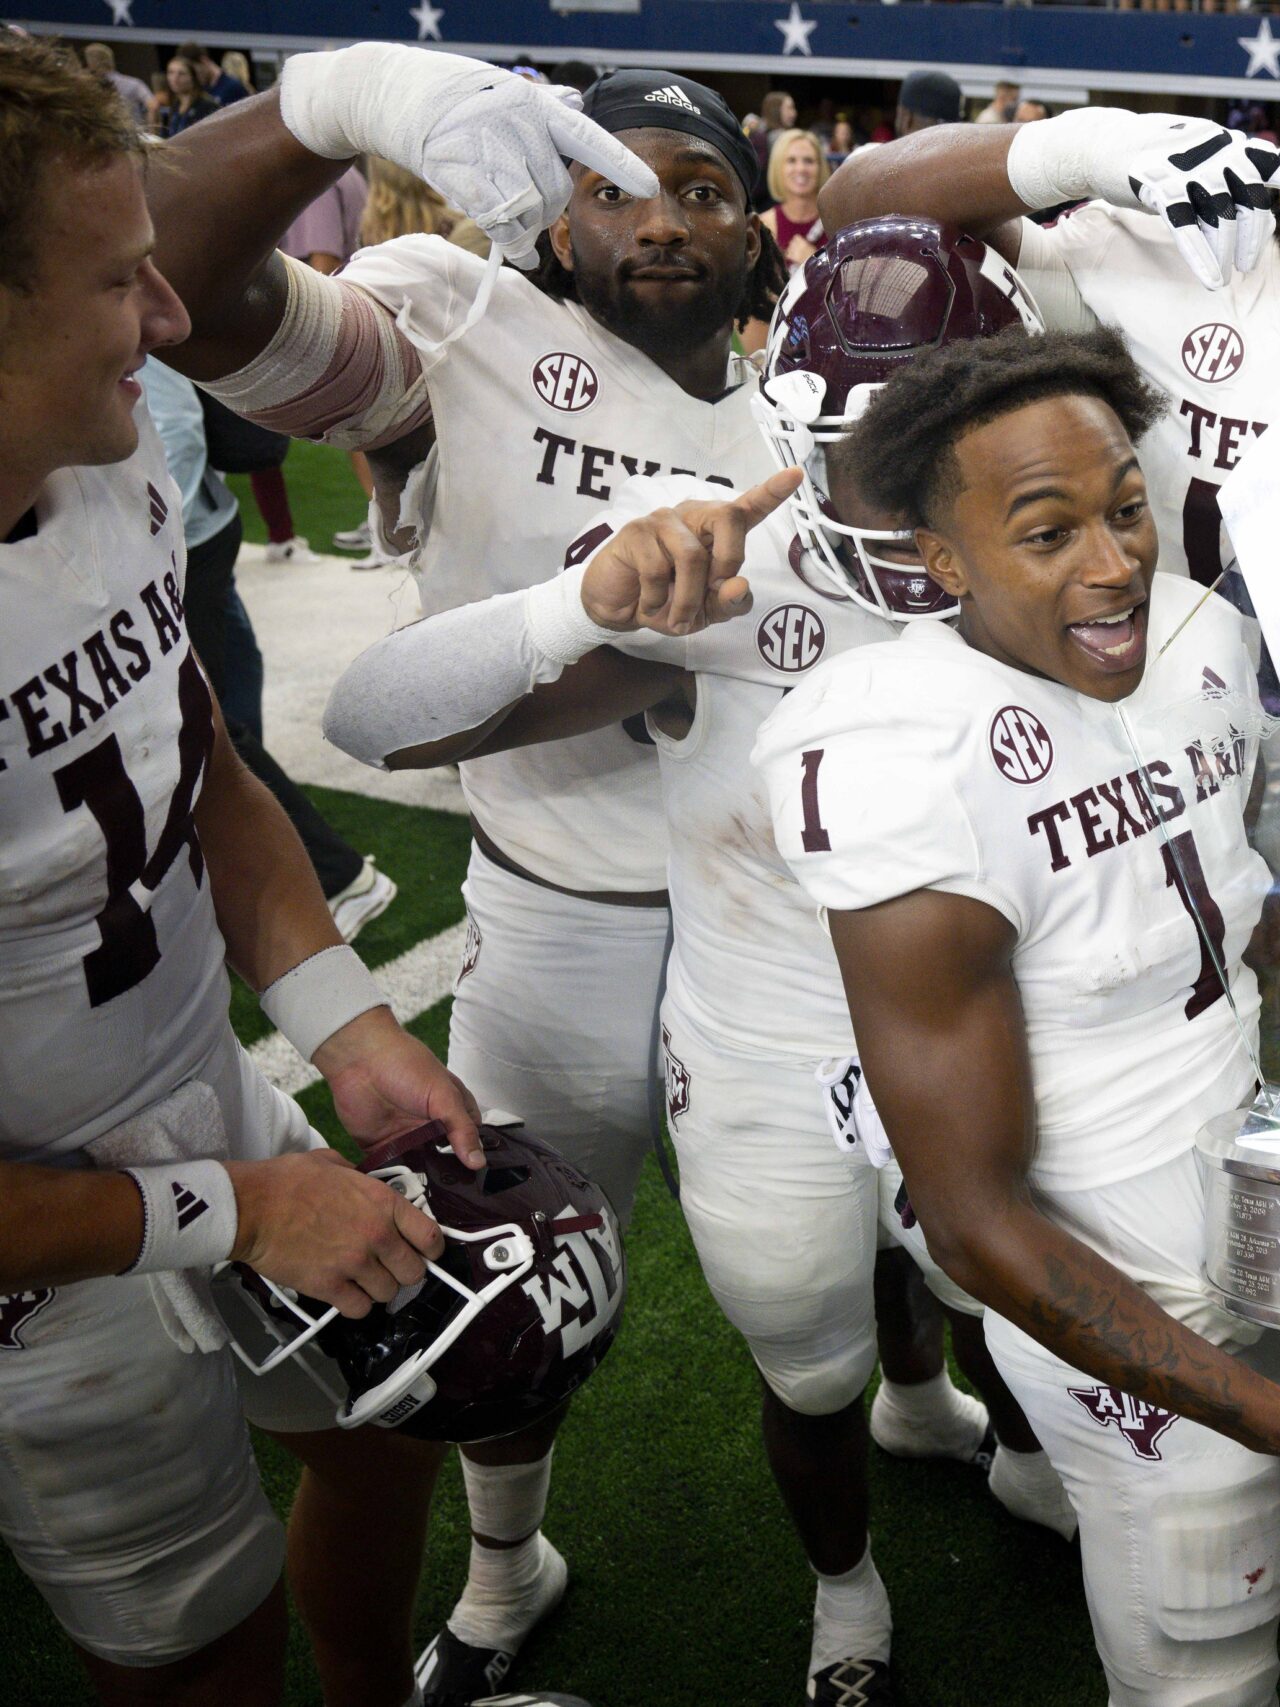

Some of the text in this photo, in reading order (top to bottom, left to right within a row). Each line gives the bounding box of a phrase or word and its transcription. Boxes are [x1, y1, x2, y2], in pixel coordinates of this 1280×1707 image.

[644, 94, 701, 115] adidas
[532, 352, 599, 412] SEC
[1180, 322, 1244, 383] SEC
[140, 550, 186, 656] A&
[756, 603, 827, 671] SEC
[988, 705, 1054, 784] SEC
[799, 749, 832, 853] 1
[1027, 759, 1185, 872] TEXAS
[1160, 829, 1226, 1021] 1
[380, 1394, 421, 1427] AGGIES
